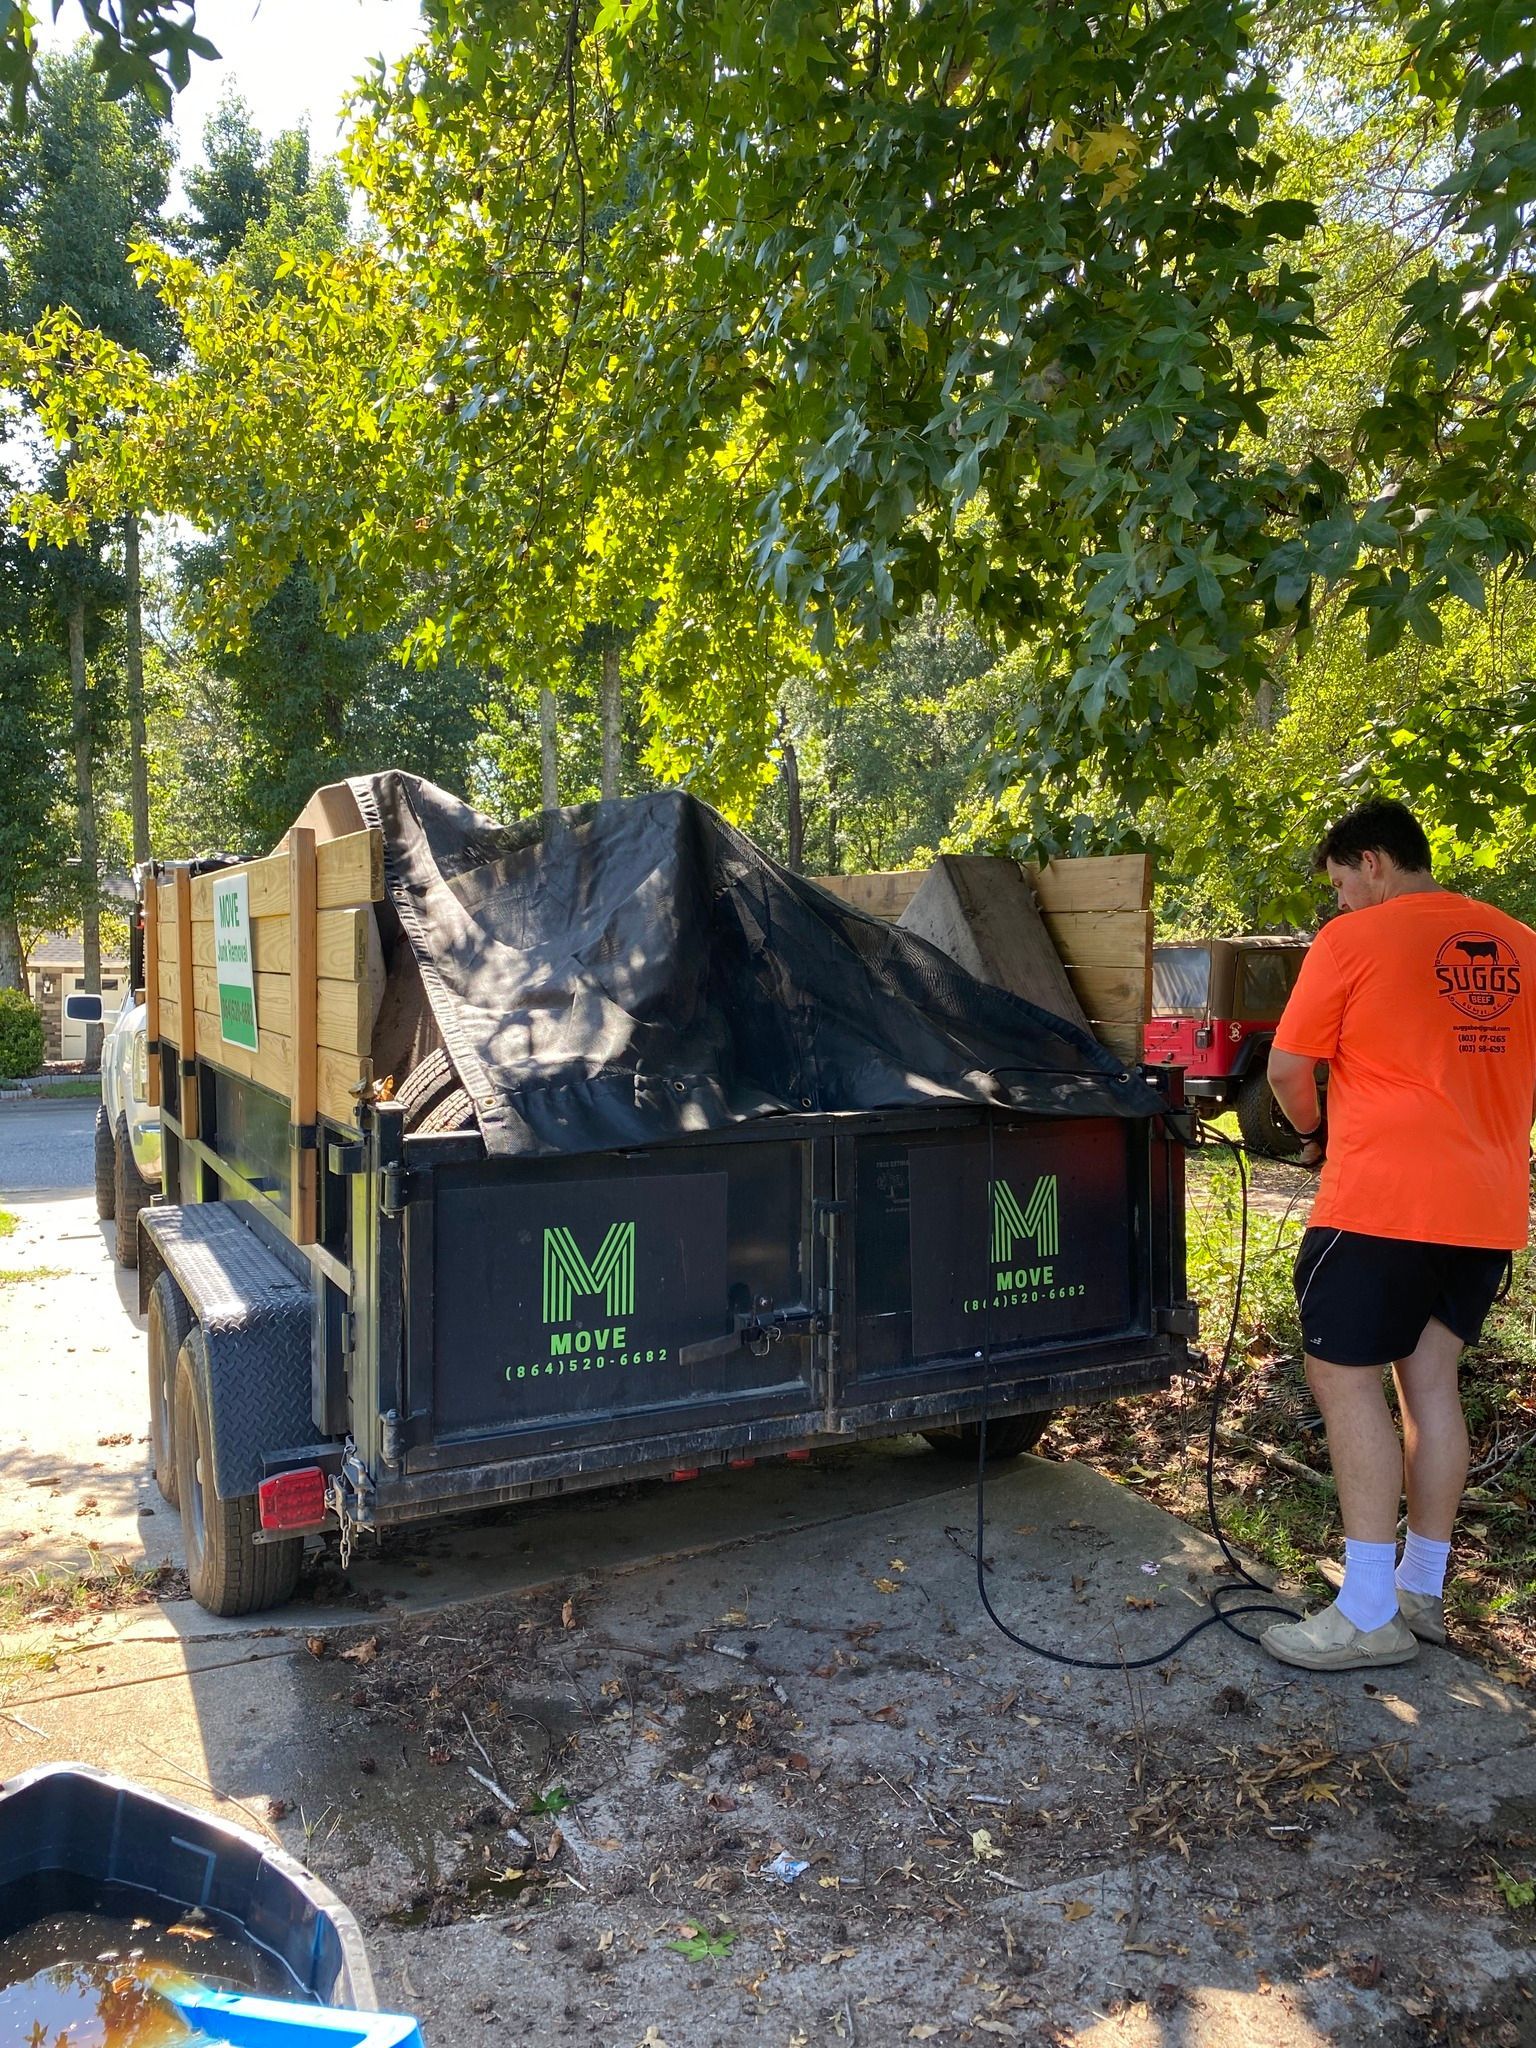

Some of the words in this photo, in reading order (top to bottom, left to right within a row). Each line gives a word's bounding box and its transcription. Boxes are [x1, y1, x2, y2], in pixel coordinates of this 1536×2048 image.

[219, 892, 240, 928] MOVE
[218, 939, 228, 963] Junk
[228, 936, 248, 963] Removal
[1435, 966, 1521, 995] SUGGS
[1471, 995, 1491, 1003] BEEF
[988, 1174, 1059, 1264] M
[542, 1221, 636, 1324] M
[996, 1265, 1054, 1291] MOVE
[550, 1326, 626, 1356] MOVE
[505, 1348, 667, 1381] (864)520-6682
